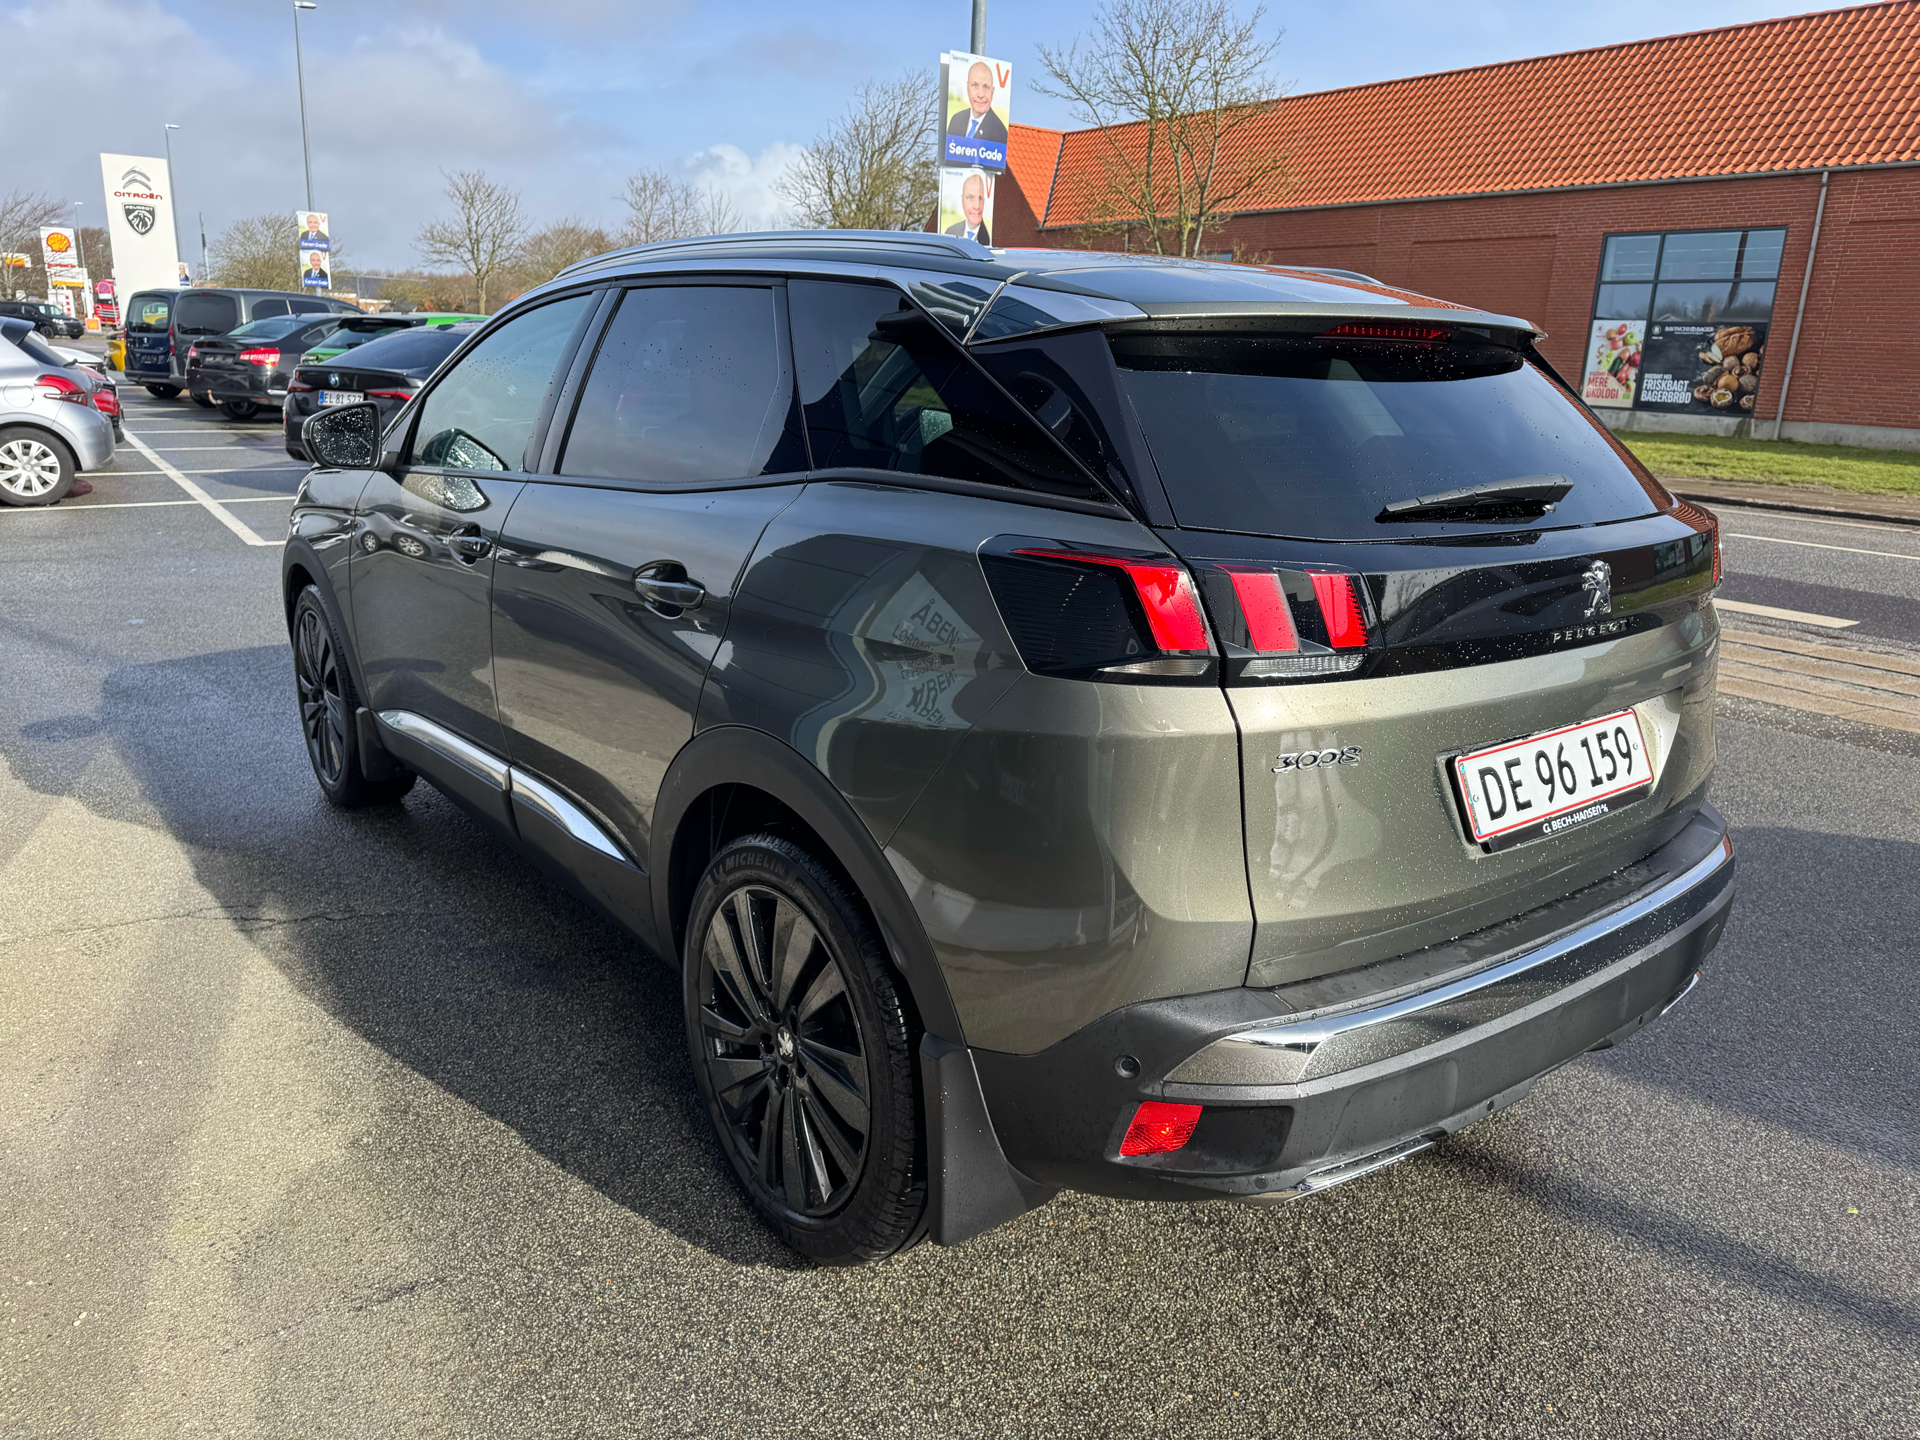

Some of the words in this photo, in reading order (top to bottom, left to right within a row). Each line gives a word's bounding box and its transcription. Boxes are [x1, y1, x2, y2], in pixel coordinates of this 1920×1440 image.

[995, 62, 1010, 88] V
[948, 142, 977, 158] Søren
[979, 145, 1003, 162] Gade
[1588, 377, 1609, 388] MERE
[1643, 379, 1690, 392] FRISKBAGT
[324, 392, 334, 403] EL
[335, 393, 344, 404] 81
[1585, 387, 1619, 400] ØKOLOGI
[1641, 391, 1692, 404] BAGERBRØD
[1552, 619, 1628, 644] PEUGEOT
[1271, 745, 1363, 774] 3008
[1477, 756, 1533, 821] DE
[1534, 742, 1577, 804] 96
[1580, 726, 1634, 788] 159
[725, 852, 786, 876] MICHELIN
